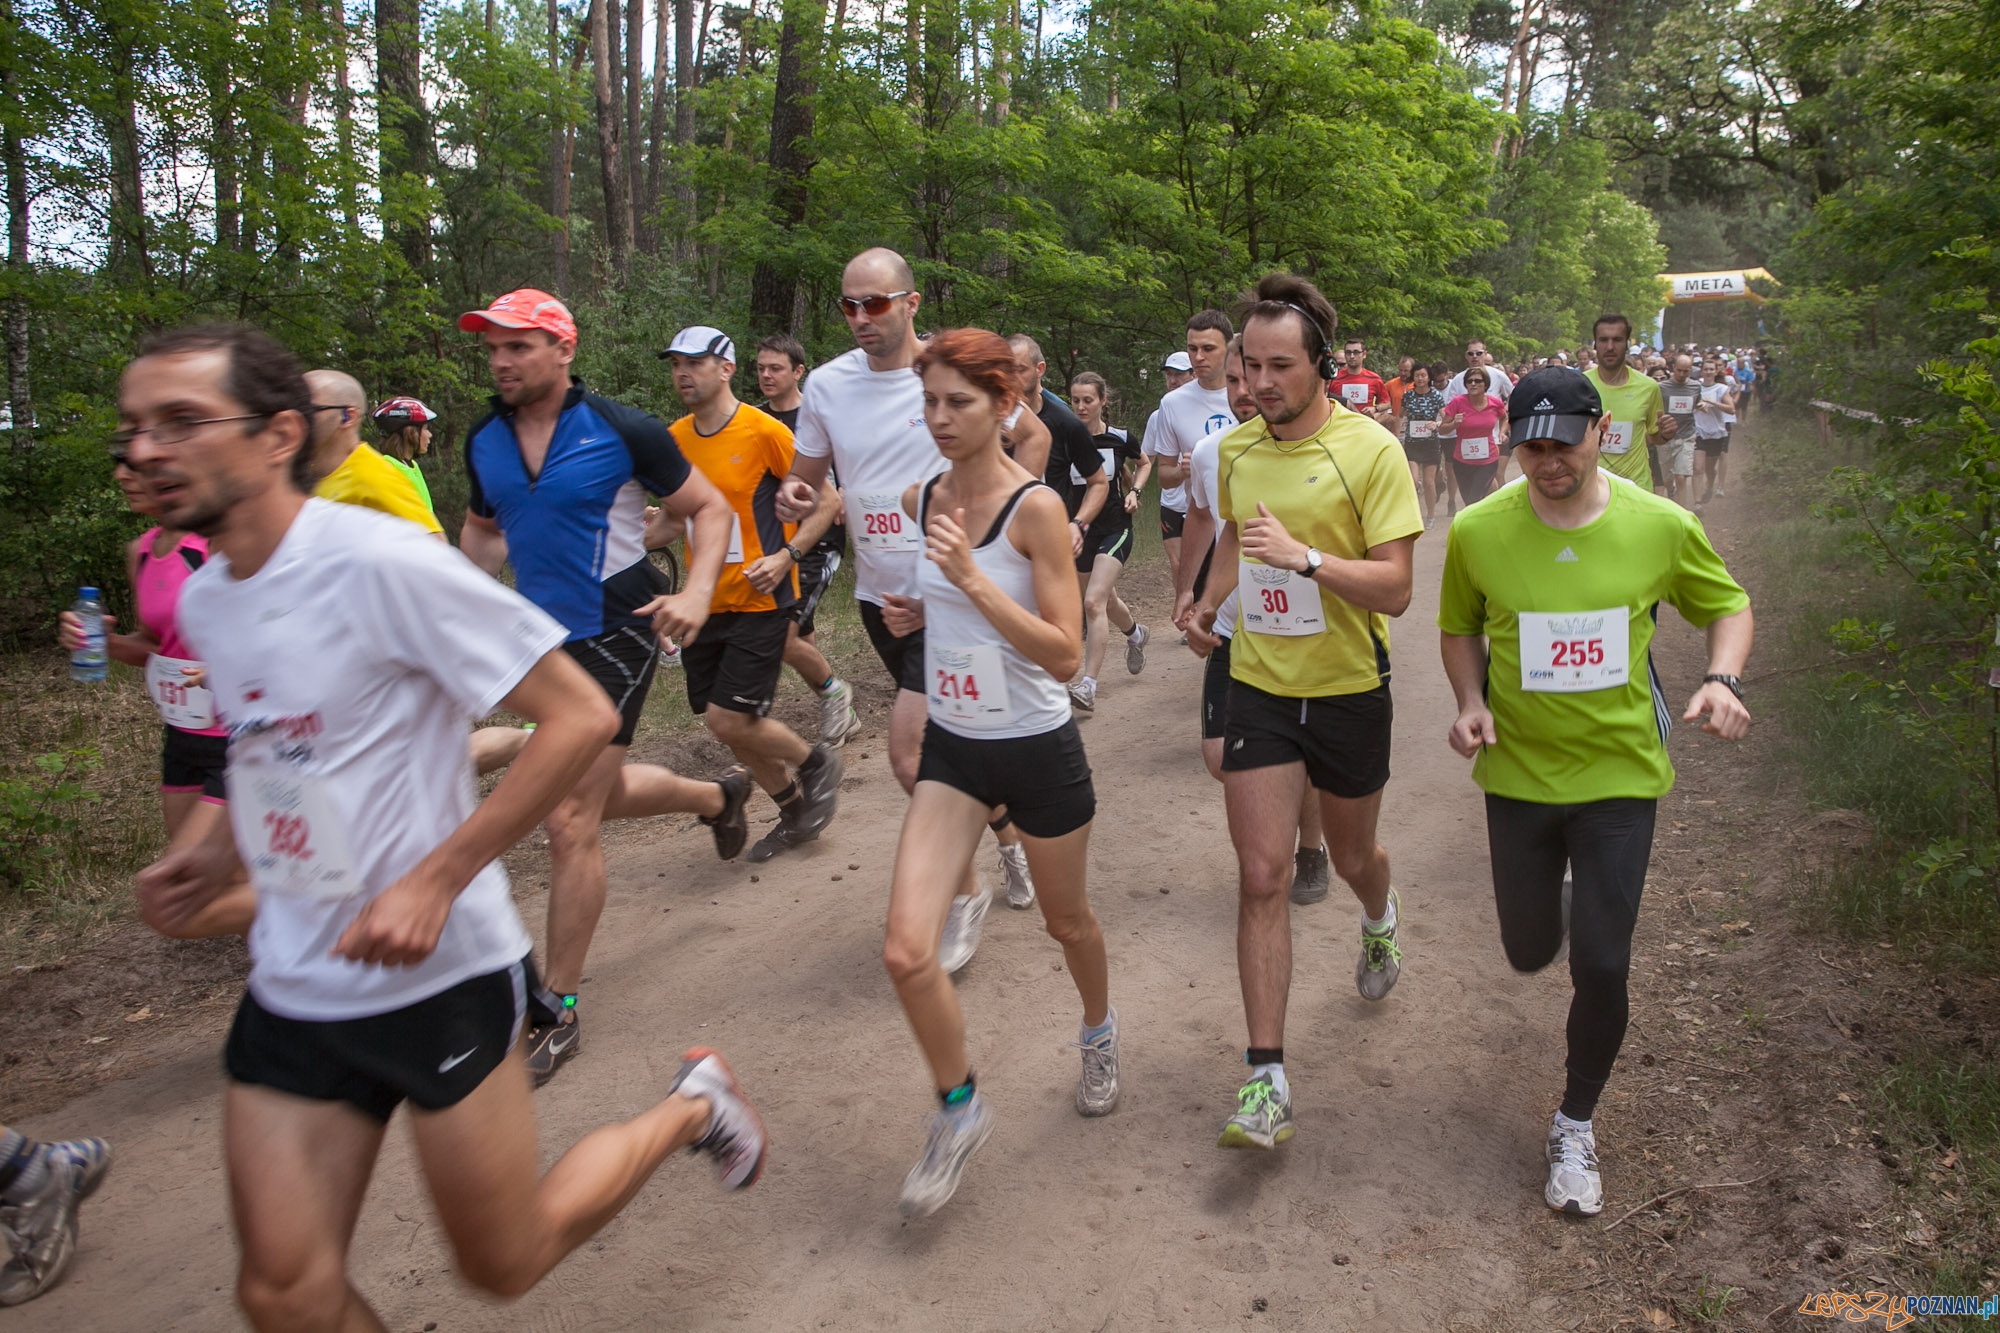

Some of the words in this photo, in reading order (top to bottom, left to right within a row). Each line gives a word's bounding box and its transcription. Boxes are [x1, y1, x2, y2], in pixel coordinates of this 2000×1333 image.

[1685, 278, 1733, 290] META
[1469, 445, 1480, 453] 35
[864, 512, 902, 535] 280
[1261, 588, 1289, 614] 30
[1550, 637, 1605, 668] 255
[936, 669, 980, 701] 214
